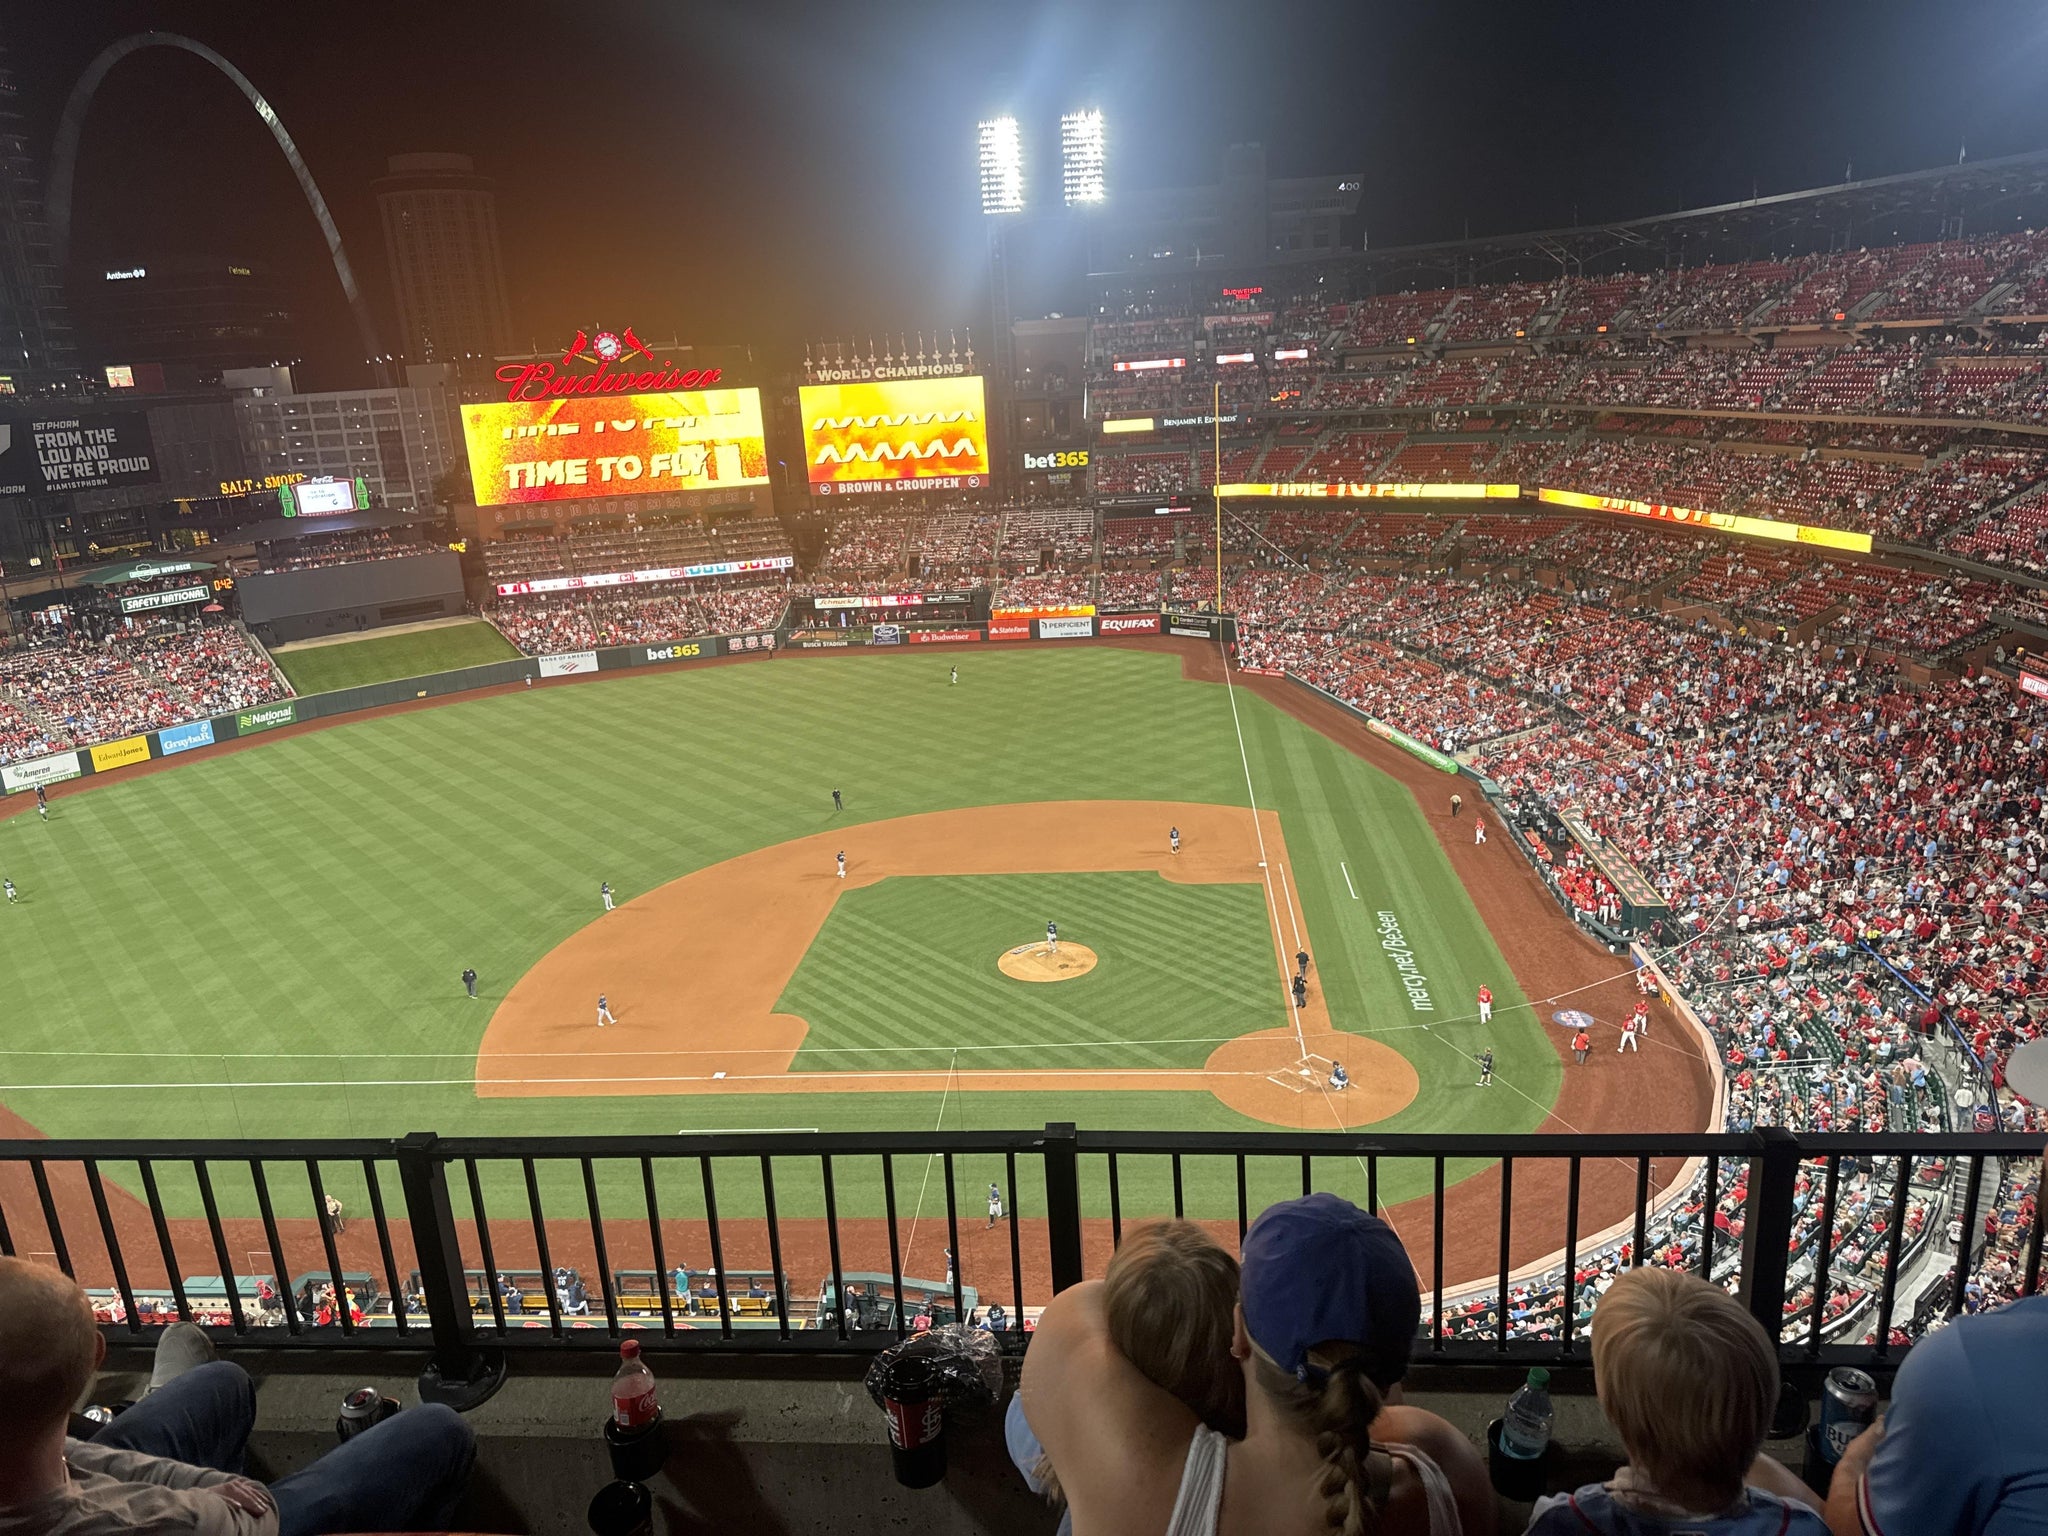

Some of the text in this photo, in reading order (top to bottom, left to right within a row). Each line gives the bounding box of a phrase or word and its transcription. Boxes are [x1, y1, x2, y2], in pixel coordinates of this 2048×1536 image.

[106, 271, 134, 281] Anthem
[1222, 287, 1263, 296] BUDWEISER
[495, 360, 722, 401] Budweiser
[816, 363, 965, 382] WORLD CHAMPIONS
[32, 420, 80, 431] 1ST PHORM
[1163, 417, 1197, 427] BENJAMIN
[34, 428, 118, 449] FROM THE
[38, 444, 110, 465] LOU AND
[1023, 450, 1090, 470] bet365
[41, 456, 151, 481] WE'RE PROUD
[504, 449, 712, 490] TIME TO FLY
[220, 478, 253, 495] SALT
[838, 477, 960, 495] BROWN & CROUPPEN
[213, 577, 233, 592] 0:42
[126, 589, 206, 611] SAFETY NATIONAL
[1048, 620, 1090, 629] PERFICIENT
[1101, 618, 1156, 631] EQUIFAX
[822, 640, 848, 648] STADIUM
[931, 632, 970, 642] Budweiser
[566, 652, 595, 661] AMERICA
[646, 643, 700, 661] bet365
[252, 706, 292, 725] National
[98, 745, 144, 763] Edward Jones
[23, 766, 51, 779] Ameren
[1376, 910, 1434, 1012] mercy.net/BeSeen
